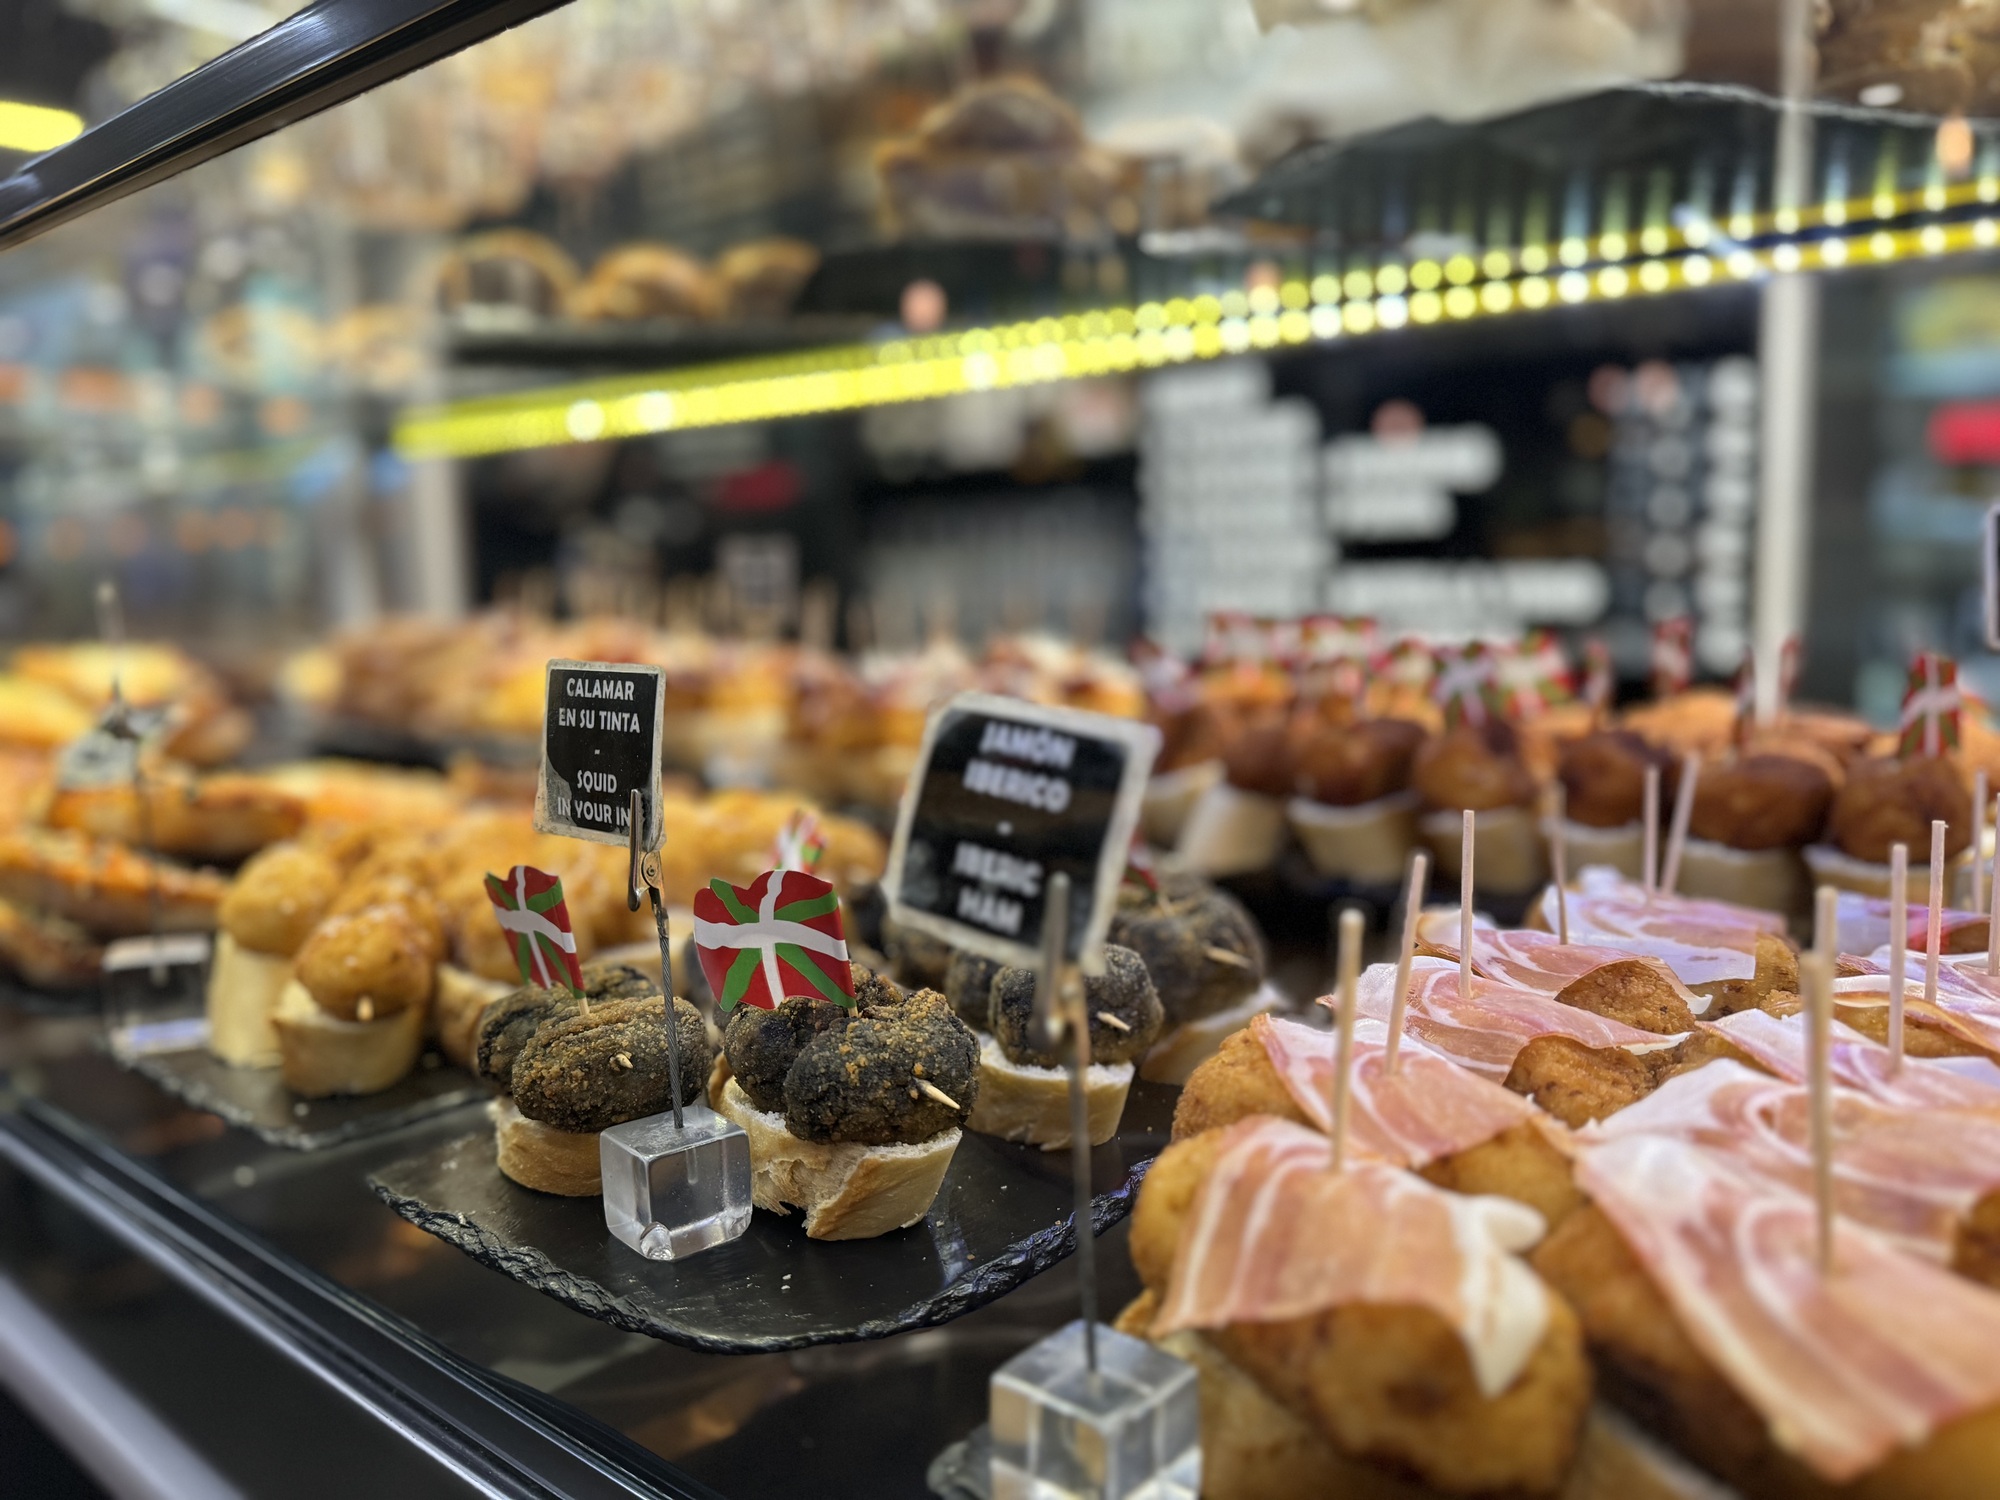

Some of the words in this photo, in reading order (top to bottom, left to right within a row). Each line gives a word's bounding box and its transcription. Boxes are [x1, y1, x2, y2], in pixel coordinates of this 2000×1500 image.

[566, 677, 635, 701] CALAMAR
[558, 707, 576, 727] EN
[579, 710, 595, 729] SU
[599, 711, 640, 733] TINTA
[981, 722, 1076, 768] JAMÓN
[577, 769, 618, 793] SQUID
[557, 796, 572, 817] IN
[574, 800, 613, 824] YOUR
[615, 806, 631, 827] IN
